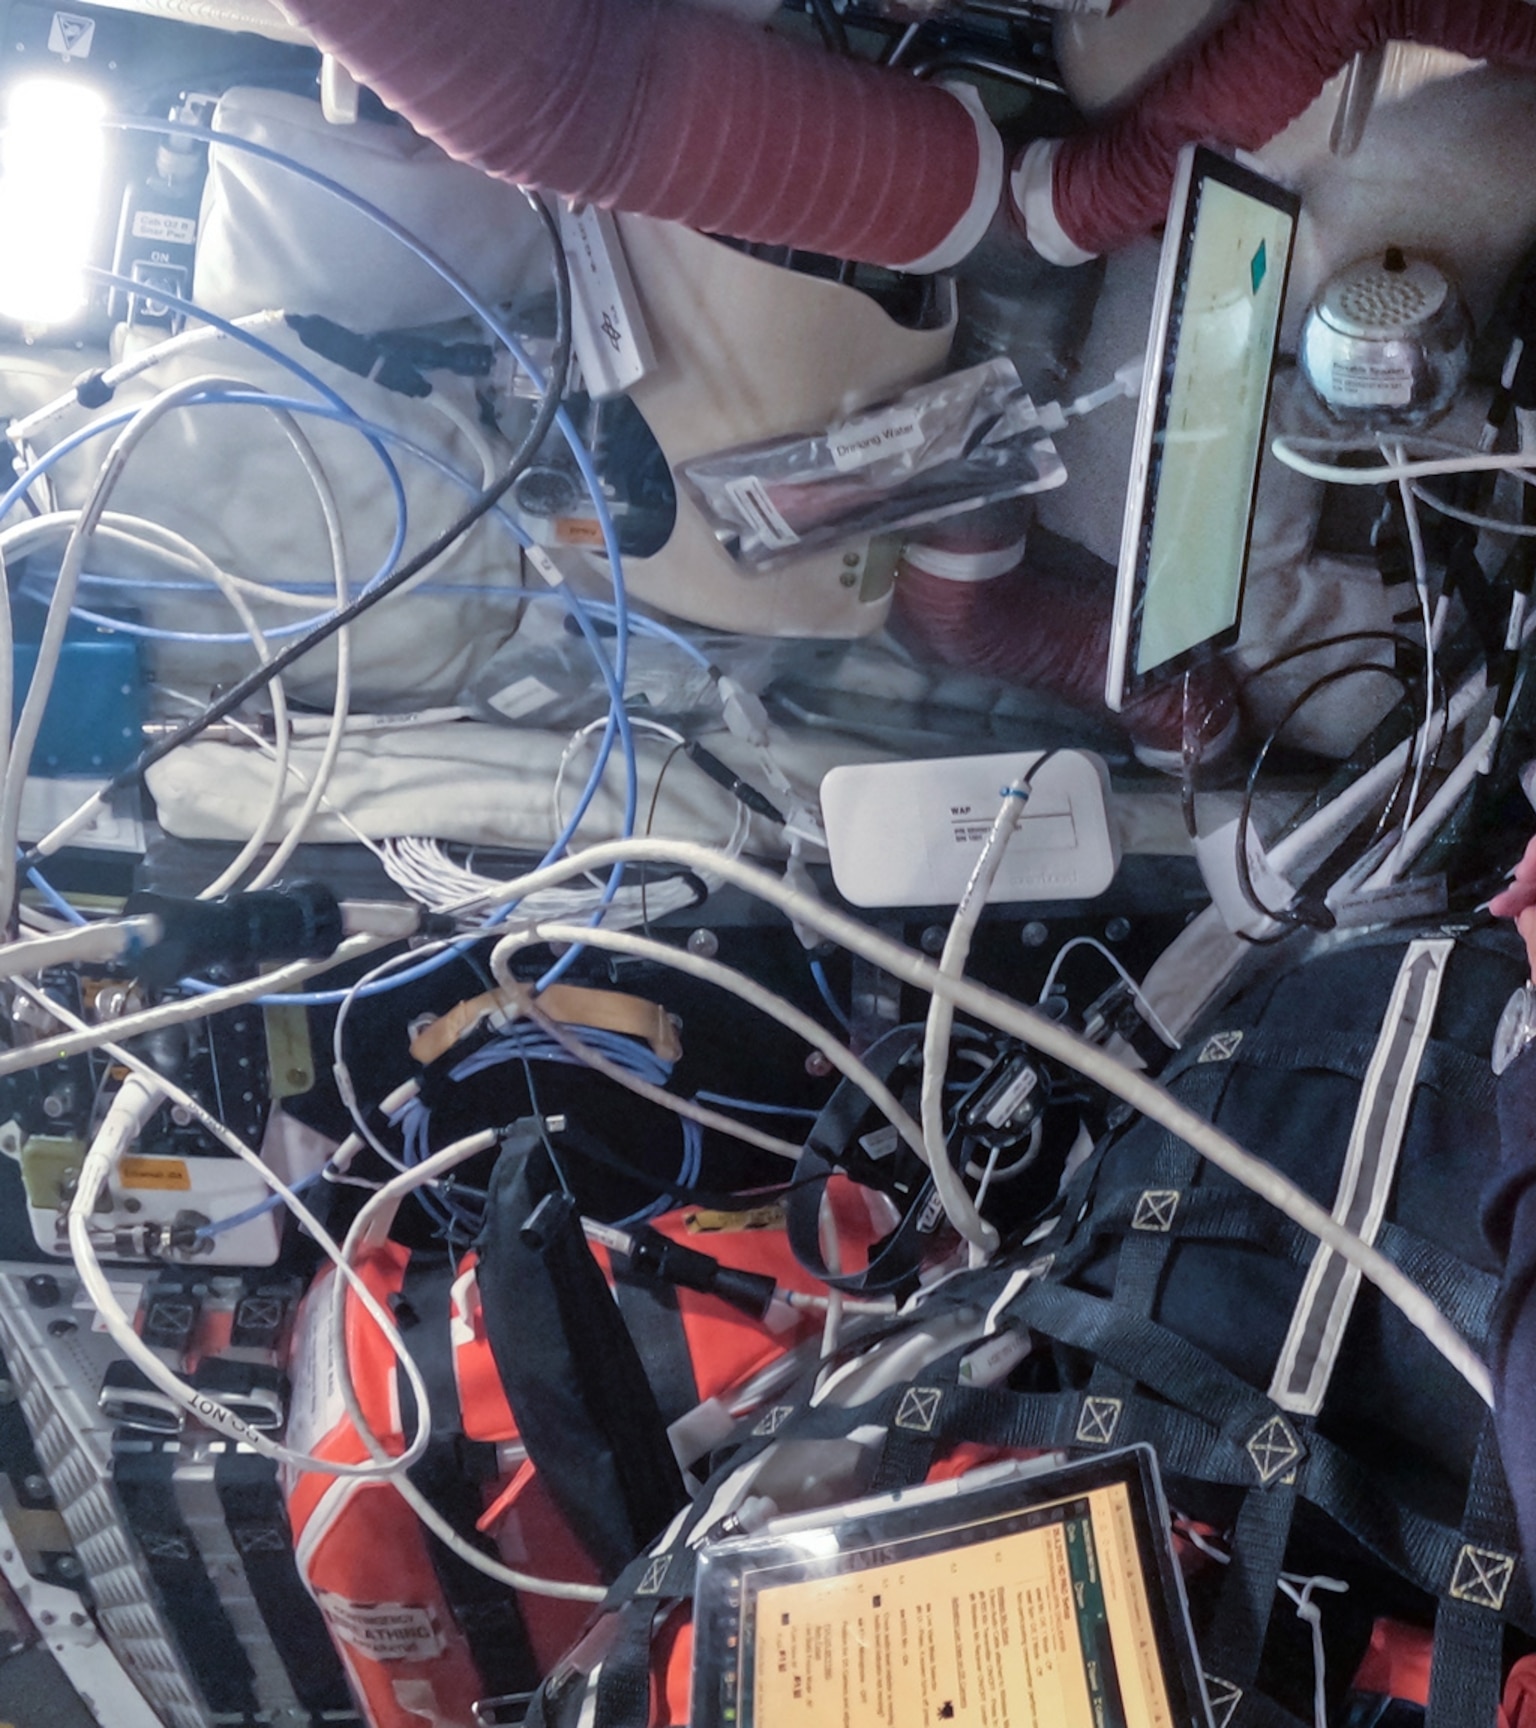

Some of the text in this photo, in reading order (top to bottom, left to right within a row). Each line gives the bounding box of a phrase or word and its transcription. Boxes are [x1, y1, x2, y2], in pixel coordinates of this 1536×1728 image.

[151, 251, 170, 263] ON
[881, 424, 913, 440] Water
[951, 806, 971, 816] WAP
[187, 1394, 228, 1424] NOT
